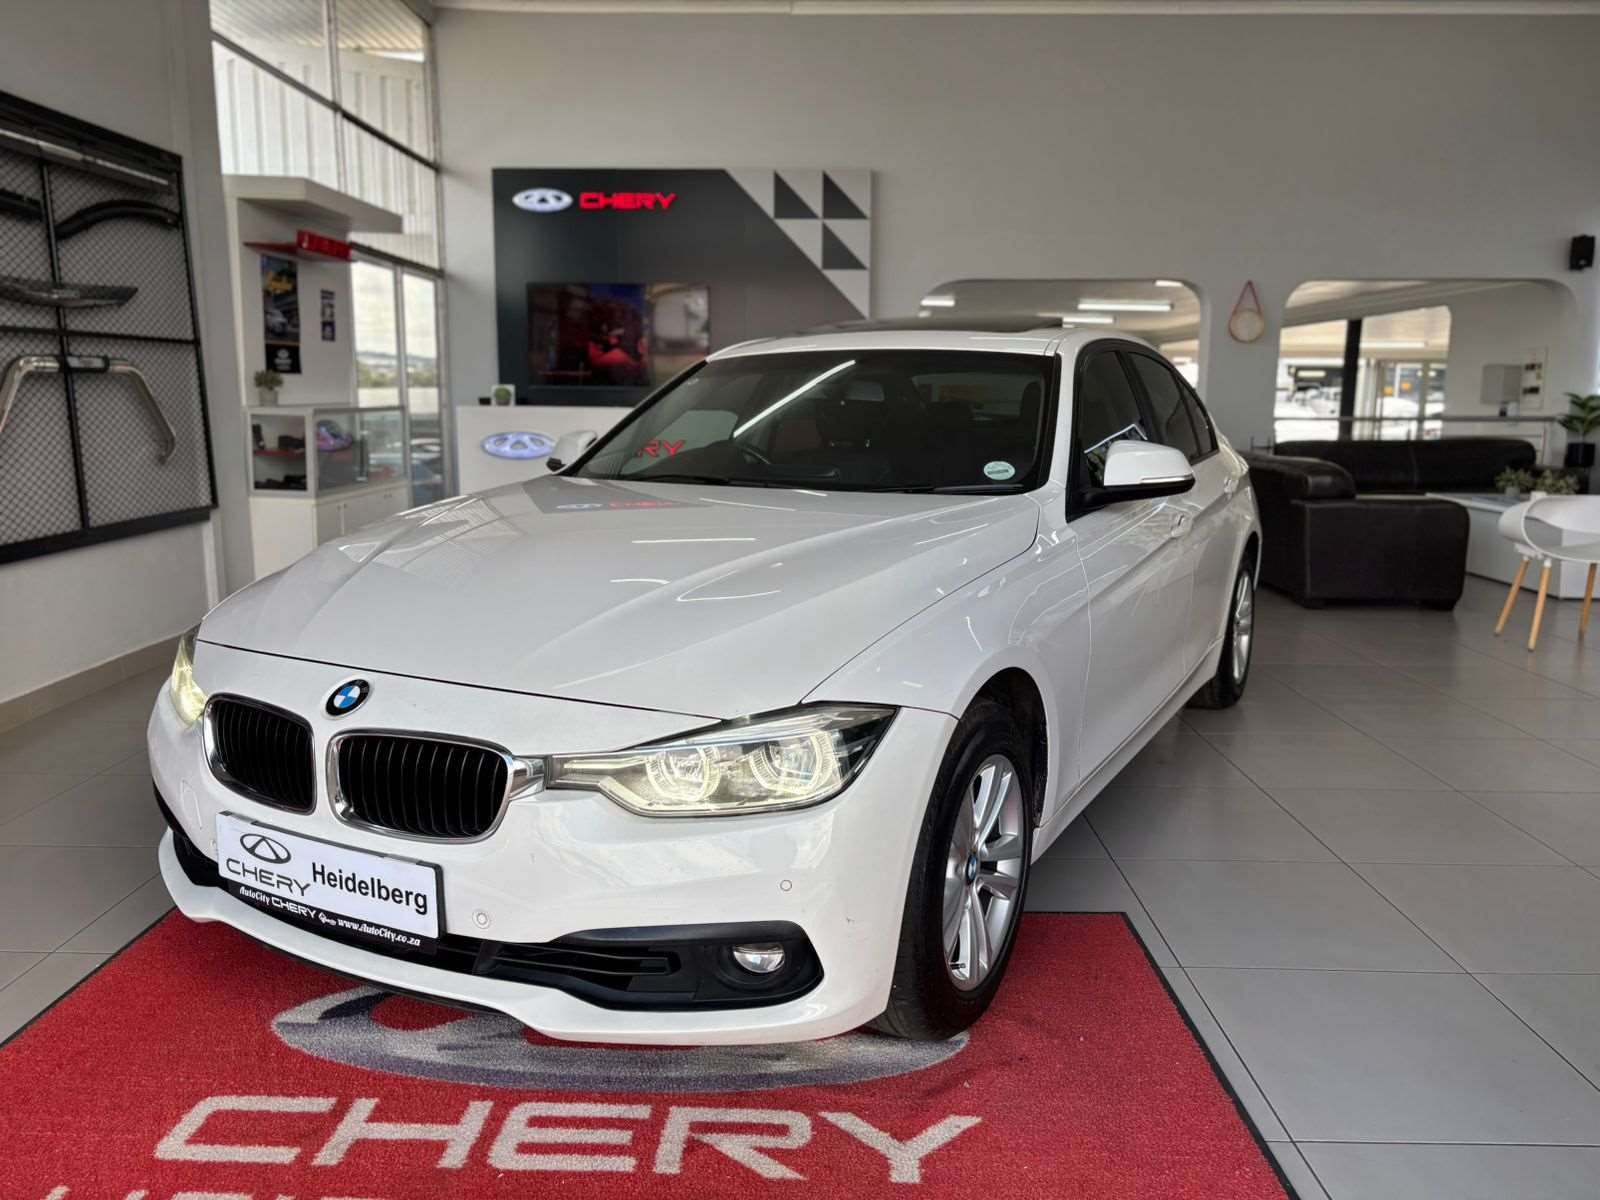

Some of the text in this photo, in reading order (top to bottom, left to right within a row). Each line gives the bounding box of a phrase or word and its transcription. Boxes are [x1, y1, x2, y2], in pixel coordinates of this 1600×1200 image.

[578, 191, 676, 210] CHERY
[226, 857, 311, 897] CHERY
[312, 861, 428, 915] Heidelberg
[239, 885, 271, 906] AutoCity
[271, 896, 316, 919] CHERY
[154, 1094, 983, 1185] CHERY
